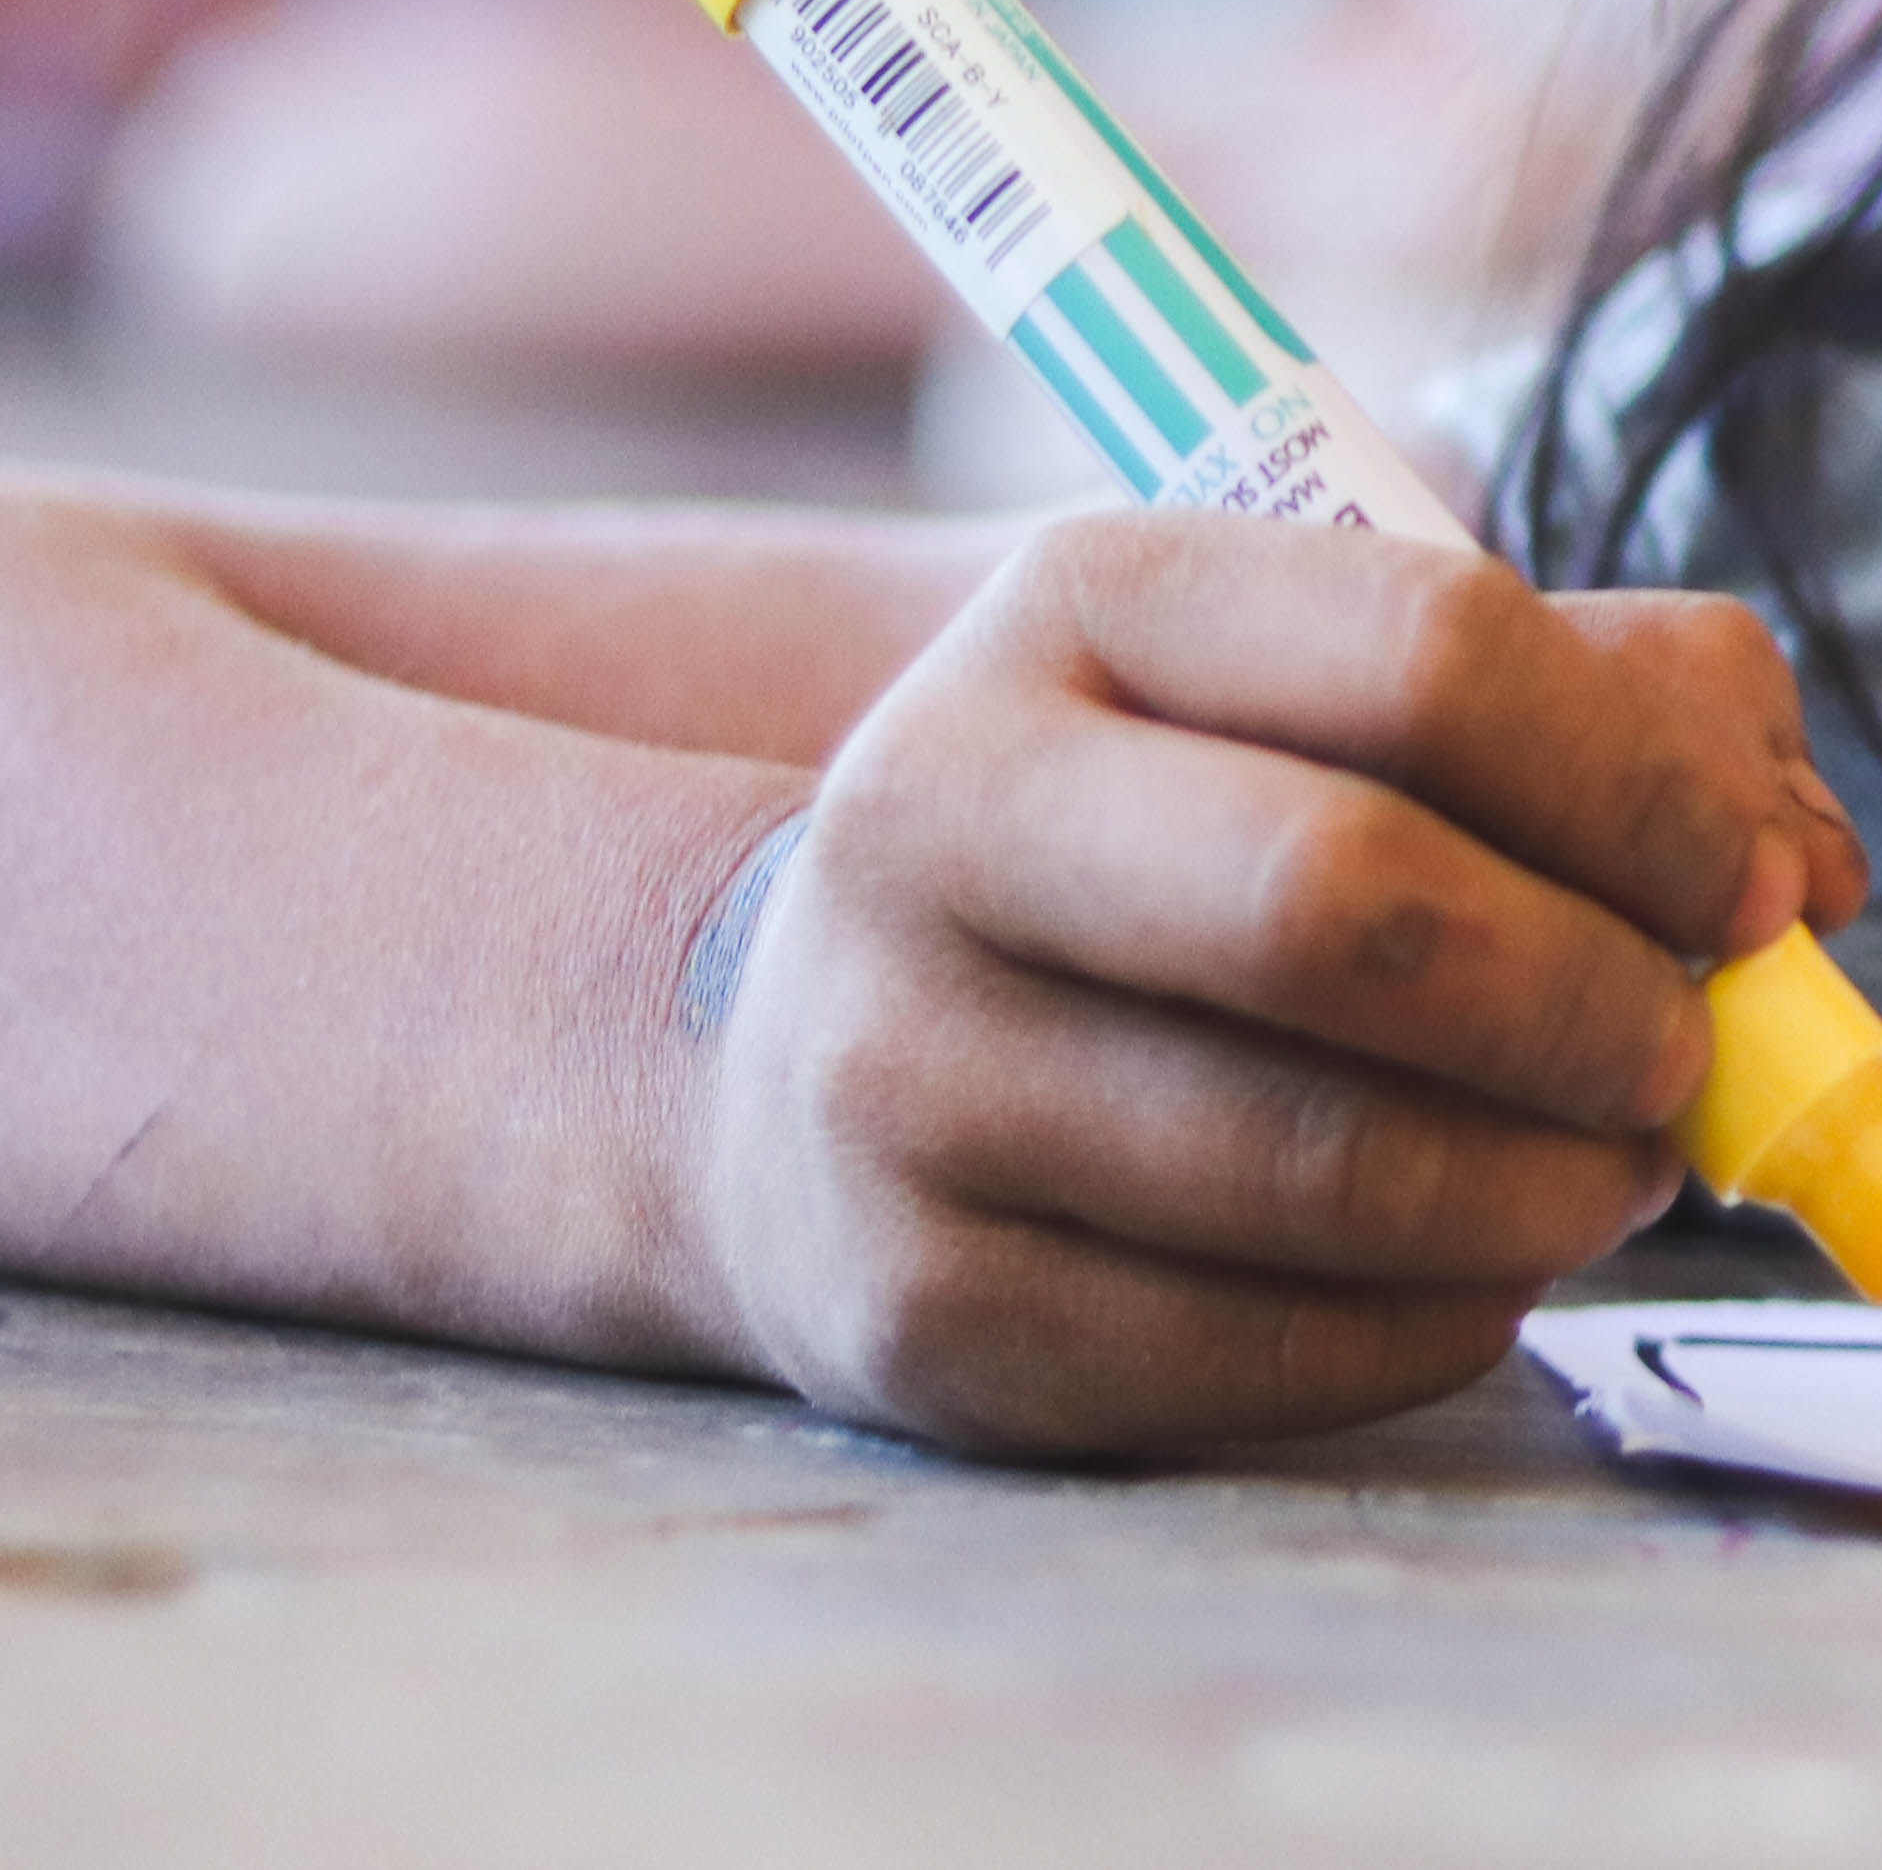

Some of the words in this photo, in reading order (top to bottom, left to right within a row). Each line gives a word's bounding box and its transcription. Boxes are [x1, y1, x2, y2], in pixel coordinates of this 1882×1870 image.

[789, 26, 859, 109] 902505
[898, 159, 971, 246] 087646
[1249, 386, 1313, 442] NO
[1167, 442, 1240, 508] XYL
[1256, 418, 1333, 489] MOST
